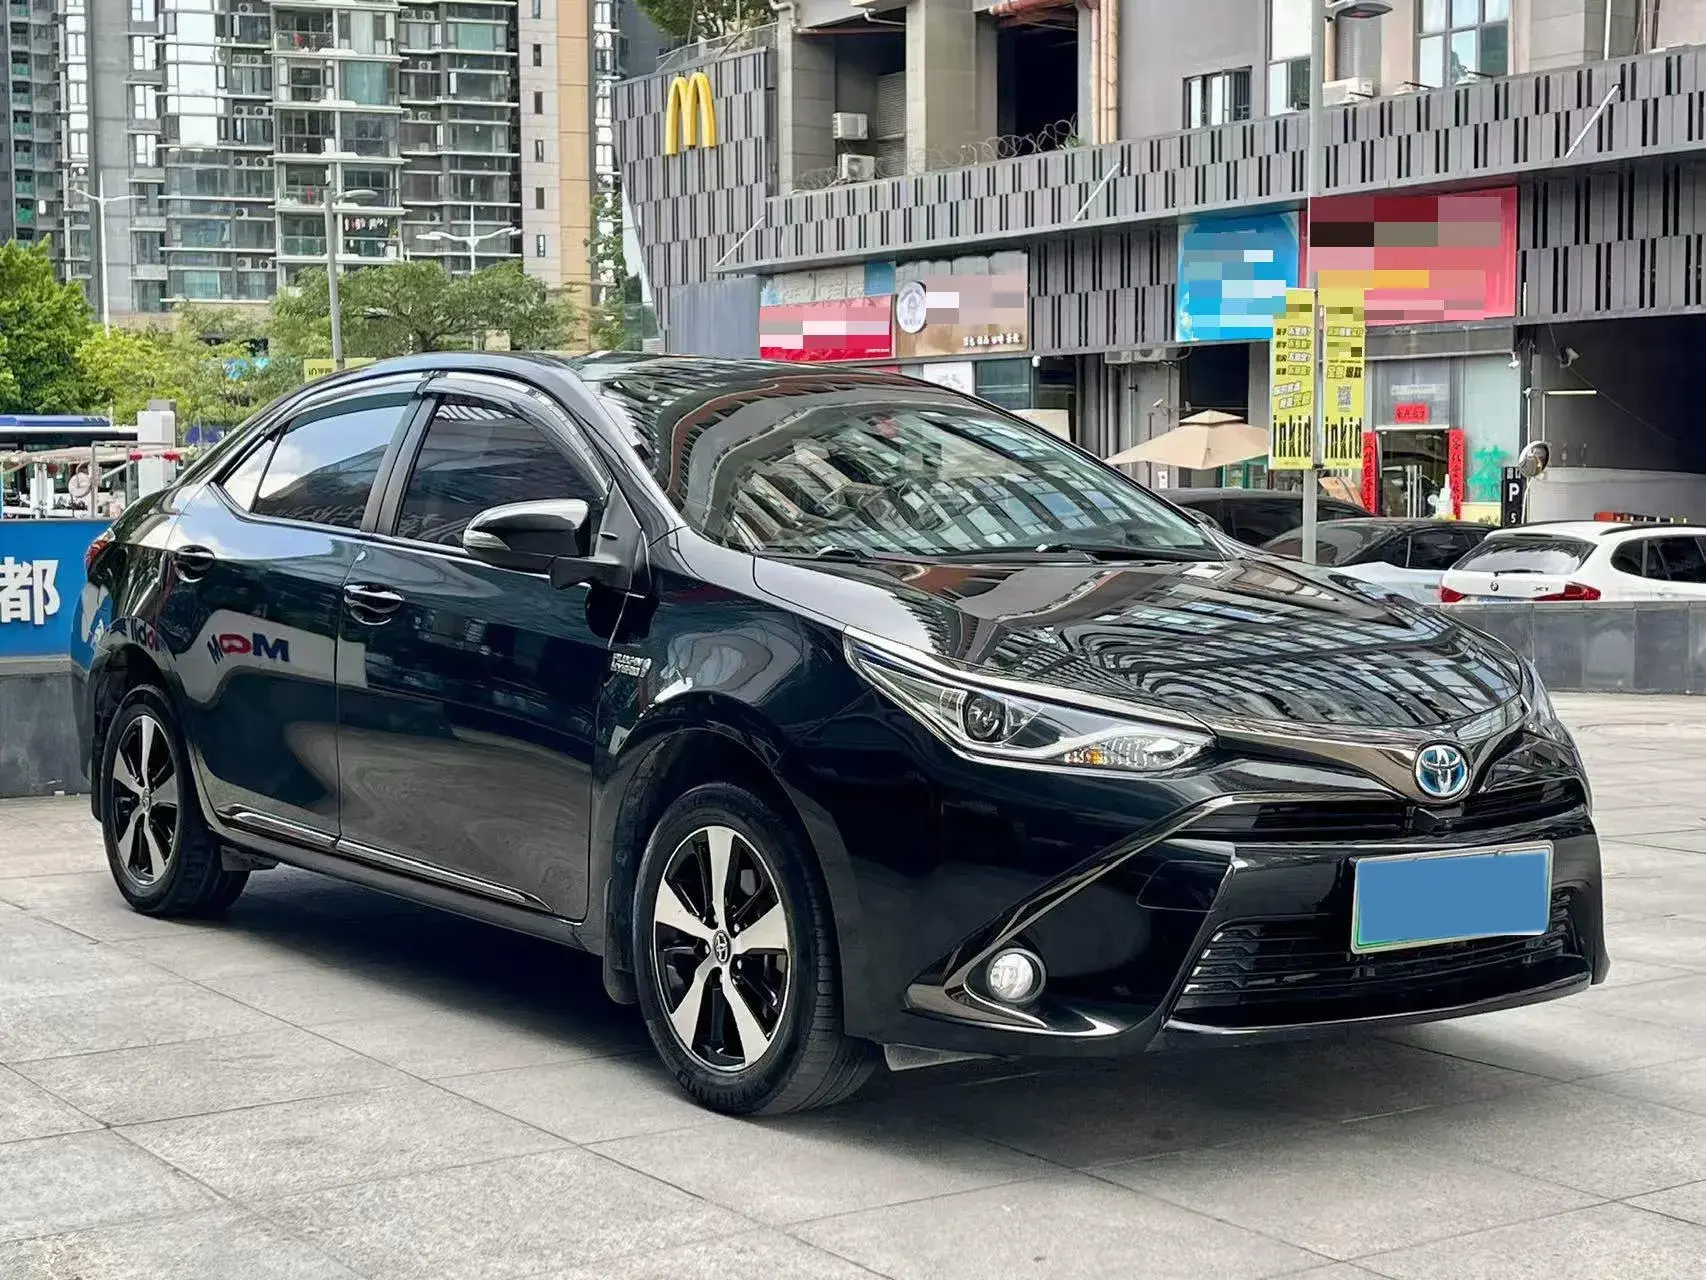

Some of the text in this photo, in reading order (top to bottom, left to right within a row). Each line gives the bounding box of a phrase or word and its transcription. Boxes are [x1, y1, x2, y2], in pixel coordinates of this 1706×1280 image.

[1273, 415, 1311, 458] inkid
[1325, 416, 1362, 459] inkid
[1509, 483, 1519, 502] P
[0, 556, 61, 626] 都
